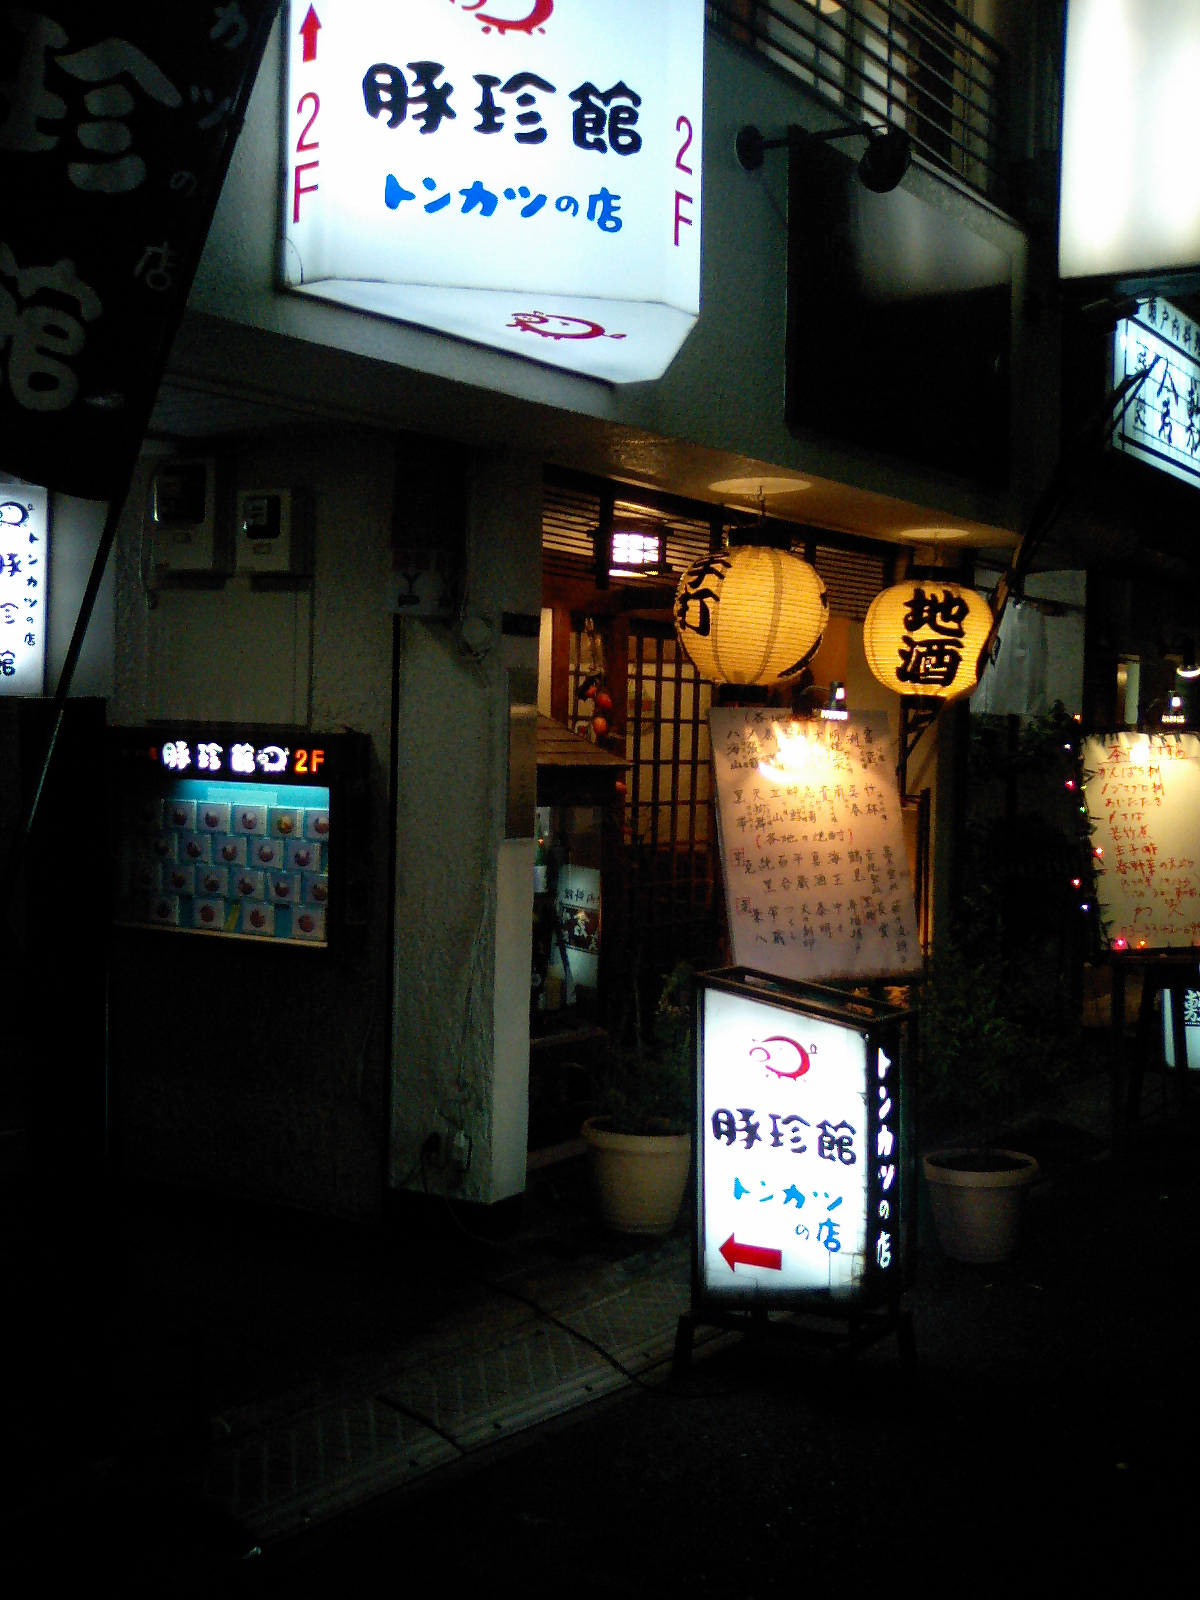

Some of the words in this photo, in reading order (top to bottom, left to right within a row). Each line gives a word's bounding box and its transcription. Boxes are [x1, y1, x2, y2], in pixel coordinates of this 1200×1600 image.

[362, 61, 642, 156] 豚珍館
[293, 91, 321, 225] 2F
[674, 114, 695, 248] 2F
[384, 173, 623, 234] トンカツの店
[24, 531, 40, 647] トンカツの店
[897, 587, 969, 687] 地酒
[161, 739, 257, 775] 豚珍館
[294, 748, 325, 775] 2F
[711, 1107, 857, 1166] 豚珍館
[877, 1046, 895, 1269] トンカツの店
[733, 1176, 843, 1212] トンカツ
[795, 1217, 842, 1254] の店
